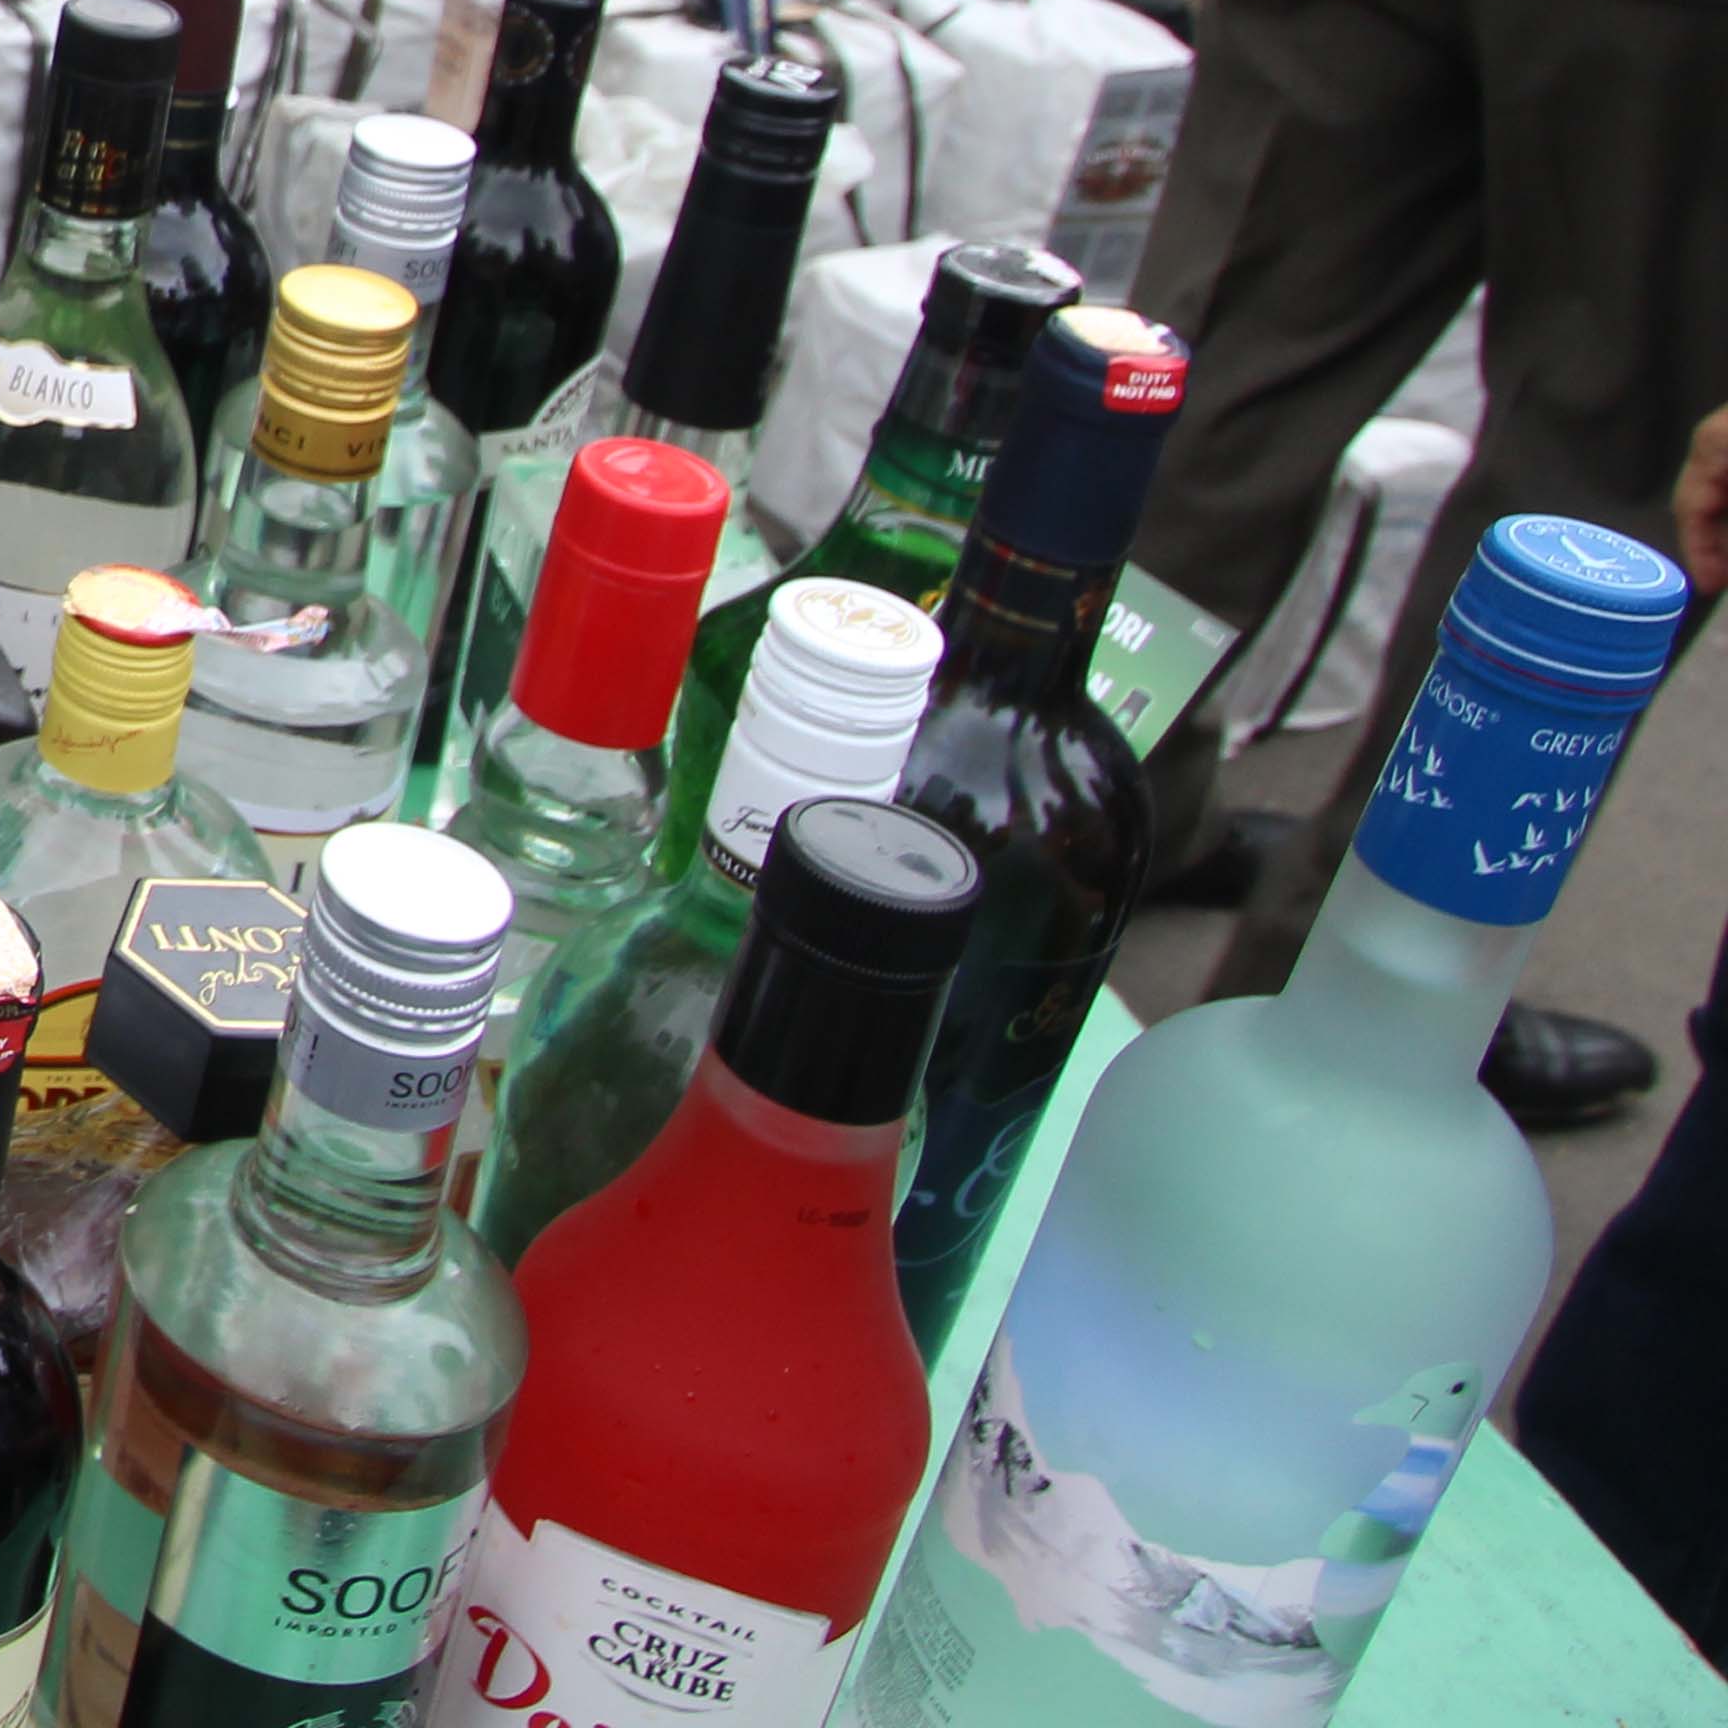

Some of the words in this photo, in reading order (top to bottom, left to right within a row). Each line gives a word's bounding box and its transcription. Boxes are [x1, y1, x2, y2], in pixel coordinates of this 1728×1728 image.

[9, 365, 94, 410] BLANCO
[1112, 384, 1145, 399] NOT
[1129, 371, 1172, 386] DUTY
[1428, 673, 1489, 730] GOOSE
[1530, 728, 1595, 756] GREY
[273, 1616, 398, 1638] IMPORTED
[600, 1577, 756, 1643] COCKTAIL
[587, 1634, 737, 1702] CARIBE
[612, 1619, 730, 1677] CRUZ
